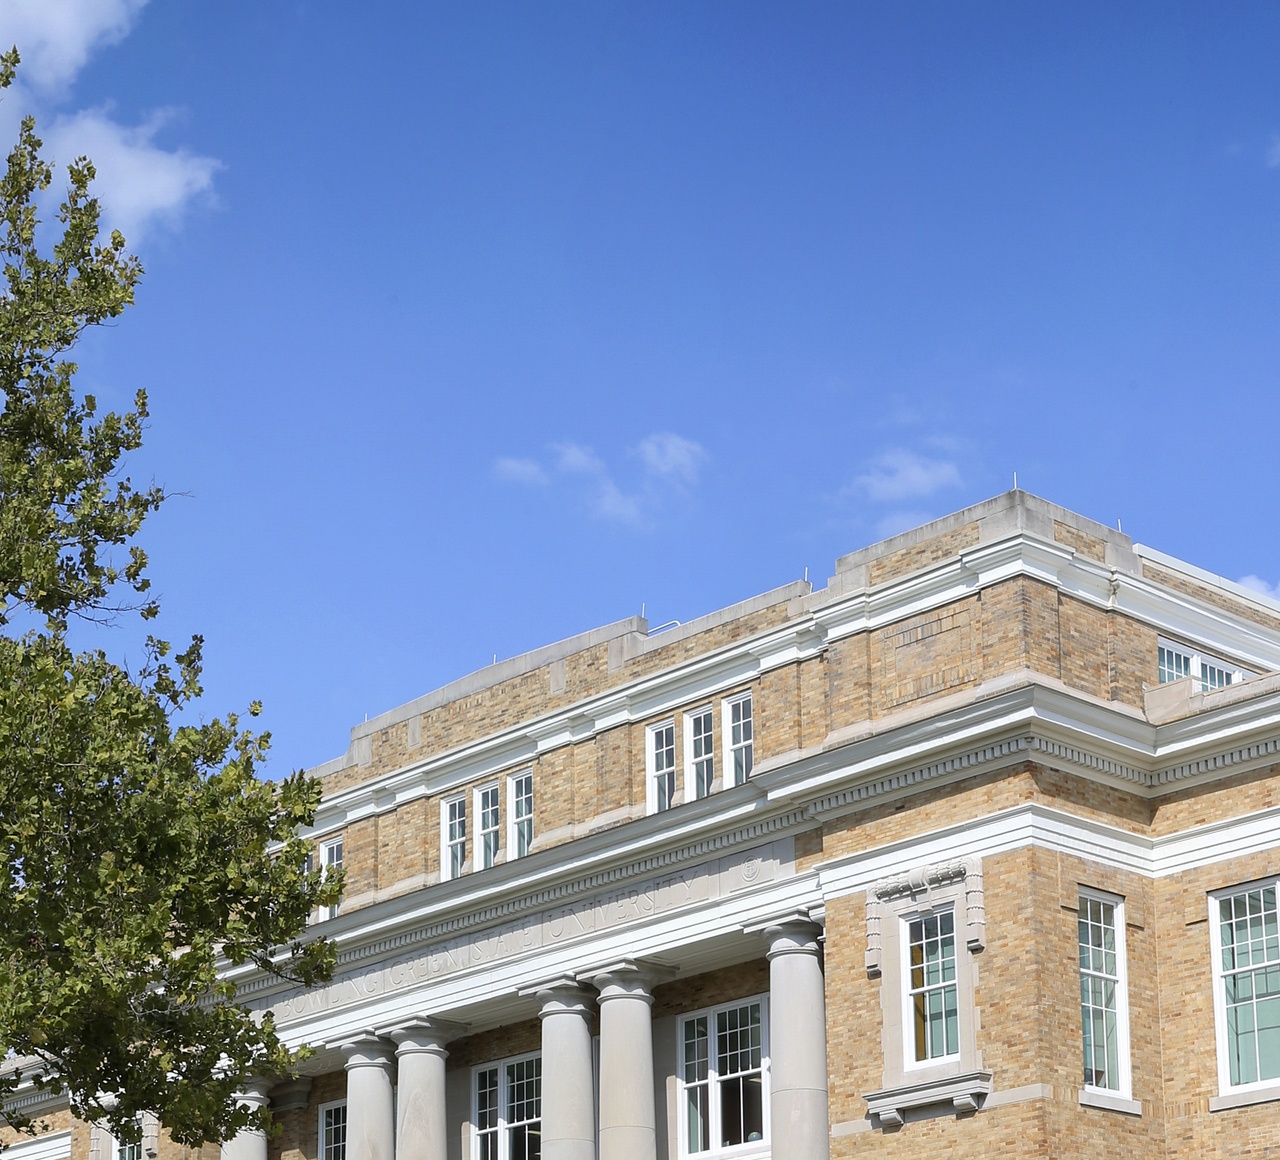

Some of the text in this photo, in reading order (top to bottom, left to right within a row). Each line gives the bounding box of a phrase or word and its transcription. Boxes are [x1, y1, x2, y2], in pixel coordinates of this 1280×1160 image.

[389, 941, 461, 985] GREEN
[471, 920, 533, 960] STATE
[548, 870, 698, 938] UNIVERSITY
